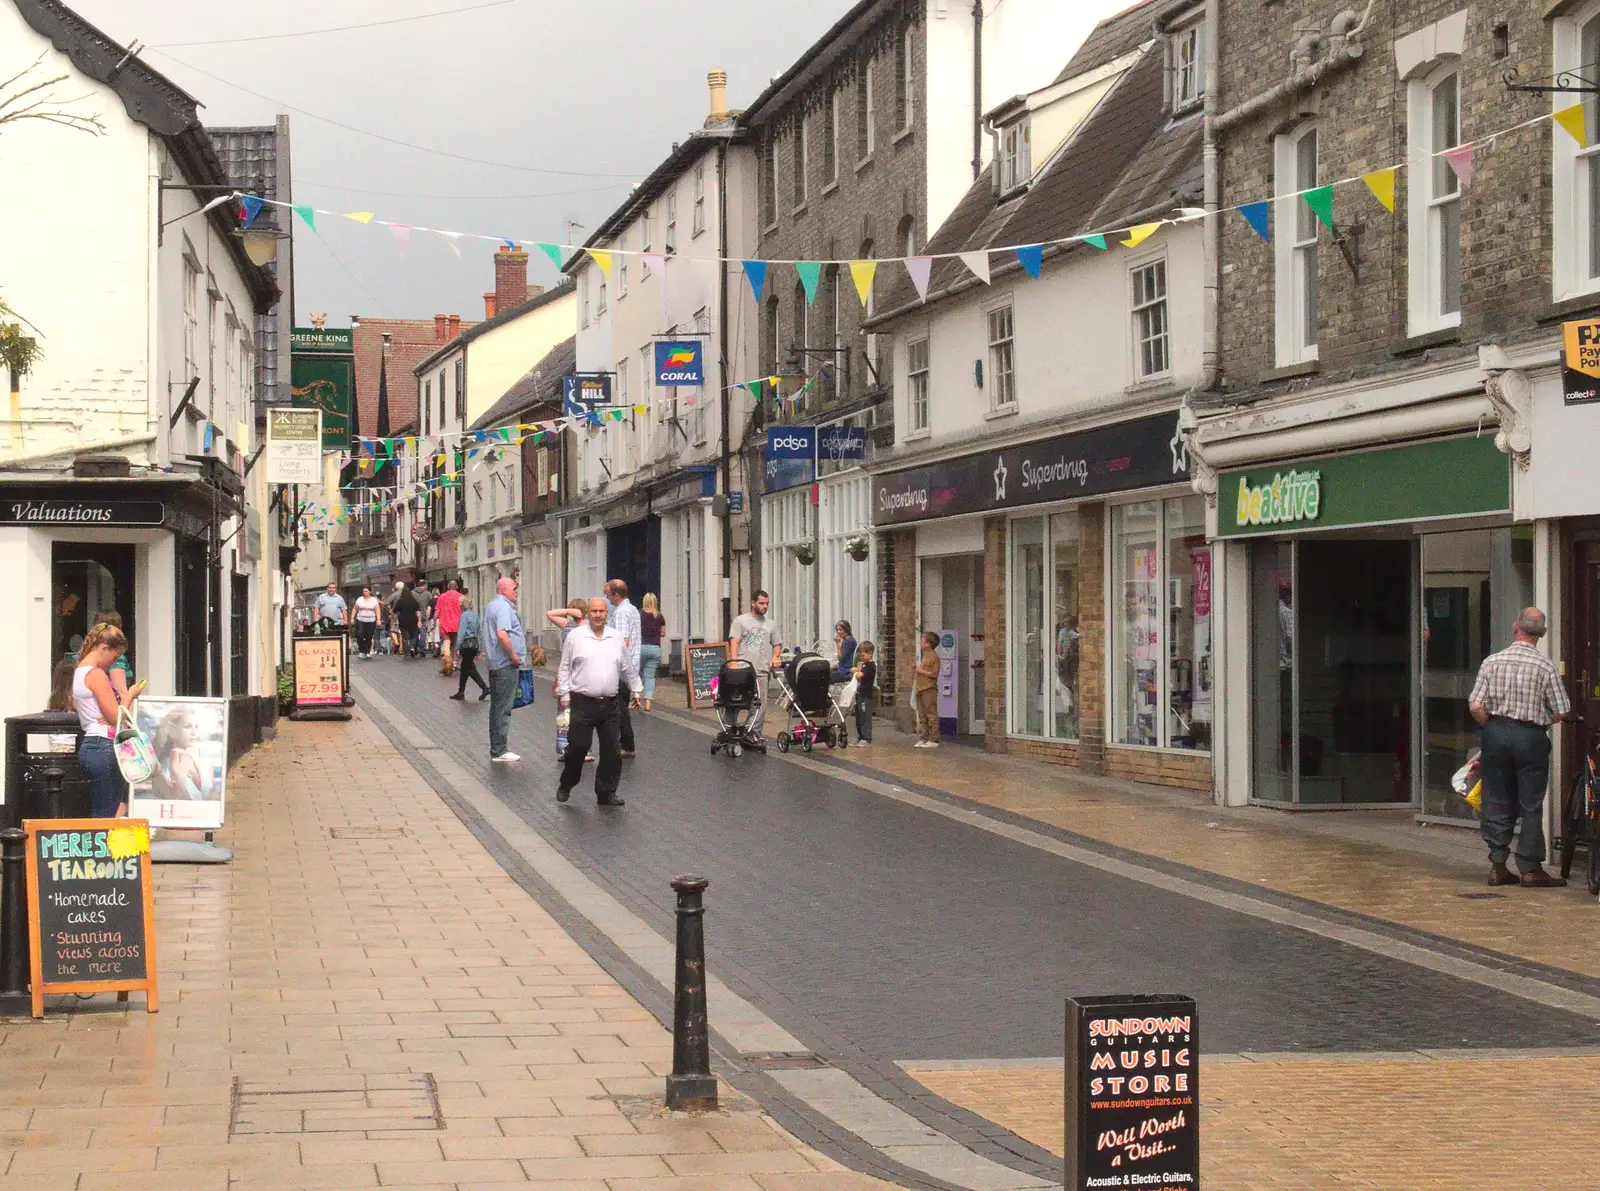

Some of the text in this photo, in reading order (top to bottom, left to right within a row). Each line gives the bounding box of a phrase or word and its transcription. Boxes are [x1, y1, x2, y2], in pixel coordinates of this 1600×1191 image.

[290, 334, 349, 343] GREENE KING
[1580, 358, 1600, 369] Poi
[660, 372, 698, 381] CORAL
[581, 388, 605, 399] HILL
[773, 434, 808, 451] pdsa
[1021, 455, 1089, 491] Superdrug
[879, 484, 928, 515] Superdrug
[11, 501, 113, 522] Valuations
[298, 648, 310, 656] EL
[299, 683, 339, 694] £7.99
[41, 831, 110, 859] MERES
[48, 858, 139, 881] TEAROOMS
[54, 887, 130, 907] Homemade
[67, 909, 107, 924] cakes
[57, 930, 122, 946] Stunning
[57, 945, 140, 959] views across
[57, 961, 123, 975] the mere
[1089, 1015, 1191, 1037] SUNDOWN
[1090, 1034, 1191, 1046] GUITARS
[1090, 1048, 1190, 1071] MUSIC
[1090, 1073, 1188, 1096] STORE
[1090, 1095, 1193, 1110] www.sundownguitars.co.uk
[1096, 1109, 1186, 1152] Well Worth
[1111, 1139, 1177, 1168] a Visit...
[1086, 1171, 1194, 1188] Acoustic & Electric Guitars,
